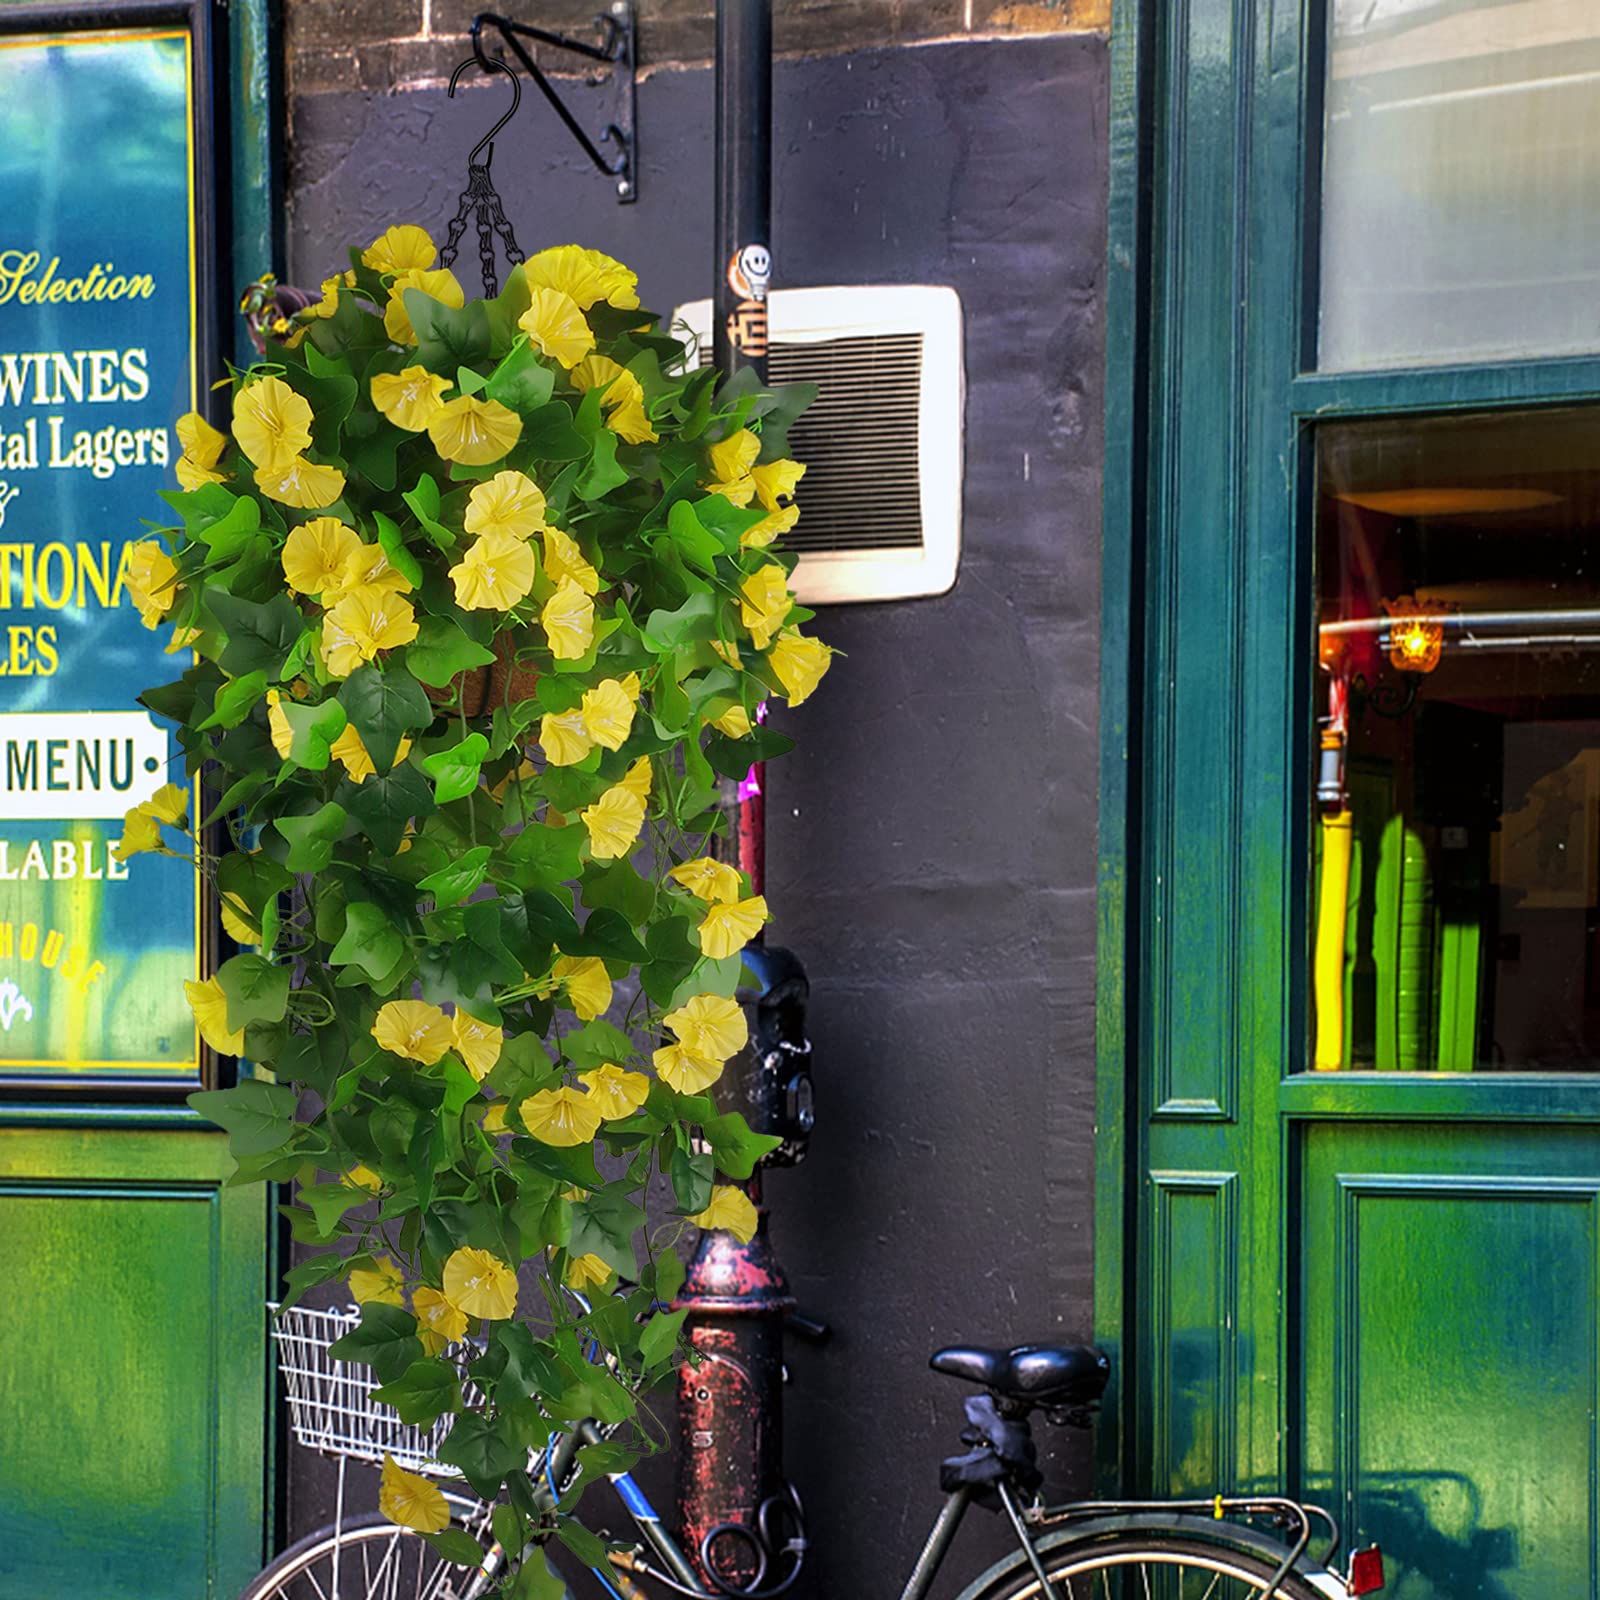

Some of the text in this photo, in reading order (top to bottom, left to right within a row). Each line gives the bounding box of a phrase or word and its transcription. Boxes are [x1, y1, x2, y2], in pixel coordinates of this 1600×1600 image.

[0, 249, 156, 304] Selection
[0, 348, 149, 407] WINES
[48, 417, 169, 479] Lagers
[6, 738, 134, 791] MENU
[0, 840, 129, 880] LABLE
